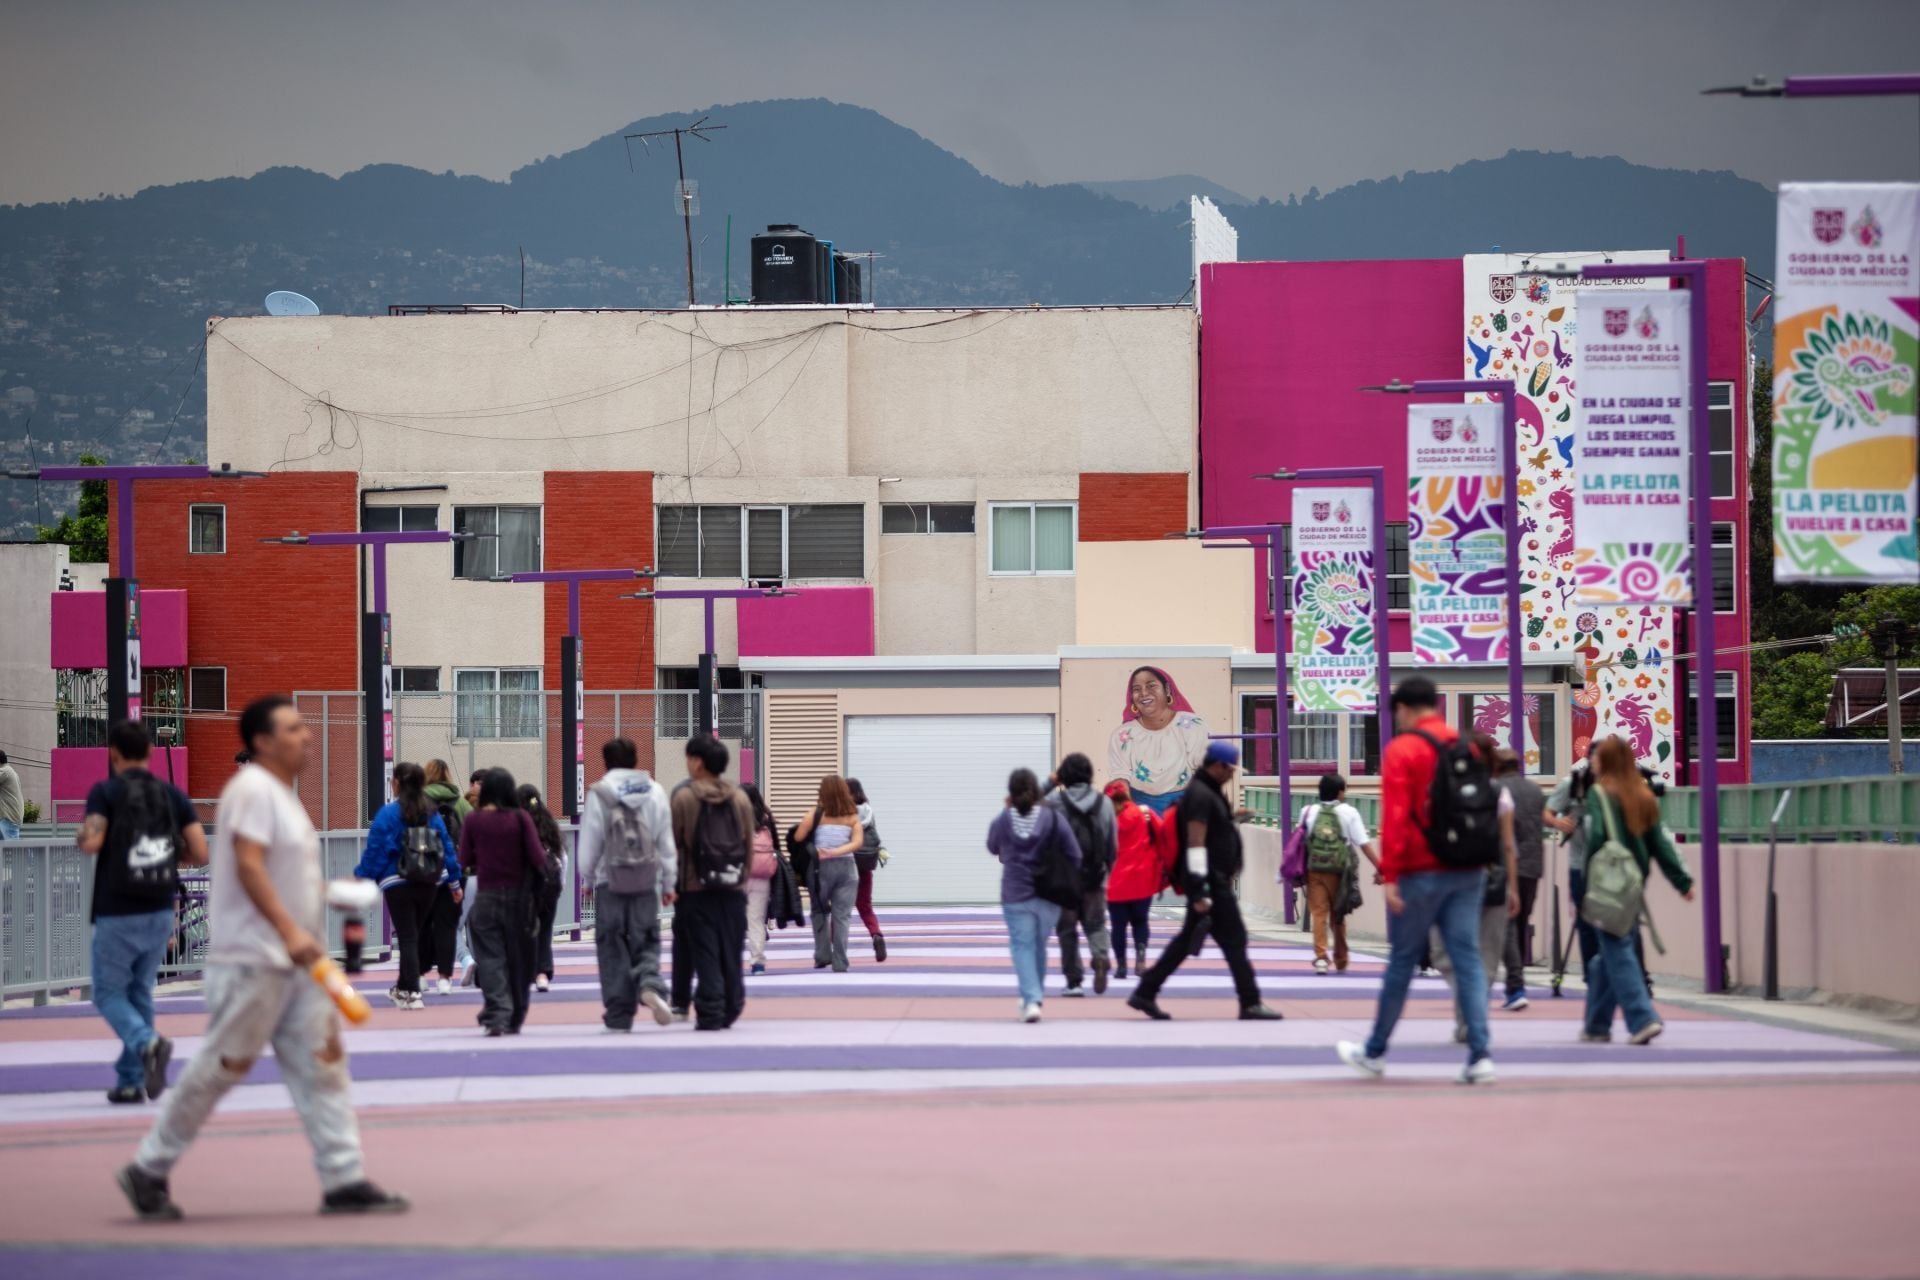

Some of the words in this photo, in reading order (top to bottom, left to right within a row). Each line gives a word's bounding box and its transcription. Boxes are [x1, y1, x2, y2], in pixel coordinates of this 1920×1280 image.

[1788, 253, 1862, 263] GOBIERNO
[1866, 253, 1886, 263] DE
[1889, 253, 1909, 263] LA
[1788, 266, 1835, 276] CIUDAD
[1839, 266, 1856, 276] DE
[1860, 264, 1909, 276] MÉXICO
[1584, 344, 1643, 352] GOBIERNO
[1646, 344, 1661, 352] DE
[1664, 344, 1680, 352] LA
[1584, 354, 1622, 362] CIUDAD
[1624, 354, 1638, 362] DE
[1582, 398, 1597, 408] EN
[1601, 398, 1615, 408] LA
[1619, 398, 1664, 408] CIUDAD
[1667, 398, 1682, 408] SE
[1588, 414, 1625, 424] JUEGA
[1628, 414, 1675, 424] LIMPIO.
[1587, 431, 1609, 441] LOS
[1613, 431, 1675, 441] DERECHOS
[1582, 447, 1634, 457] SIEMPRE
[1638, 447, 1681, 457] GANAN
[1583, 474, 1605, 490] LA
[1611, 474, 1680, 490] PELOTA
[1583, 493, 1631, 505] VUELVE
[1635, 493, 1644, 505] A
[1647, 493, 1681, 505] CASA
[1785, 493, 1813, 512] LA
[1819, 493, 1907, 513] PELOTA
[1786, 517, 1846, 531] VUELVE
[1850, 517, 1861, 531] A
[1865, 517, 1908, 532] CASA
[1418, 598, 1437, 611] LA
[1441, 597, 1499, 611] PELOTA
[1418, 614, 1459, 624] VUELVE
[1462, 614, 1470, 623] A
[1472, 613, 1500, 622] CASA
[1302, 656, 1317, 667] LA
[1320, 656, 1366, 667] PELOTA
[1302, 669, 1335, 677] VUELVE
[1336, 669, 1343, 677] A
[1344, 668, 1367, 677] CASA
